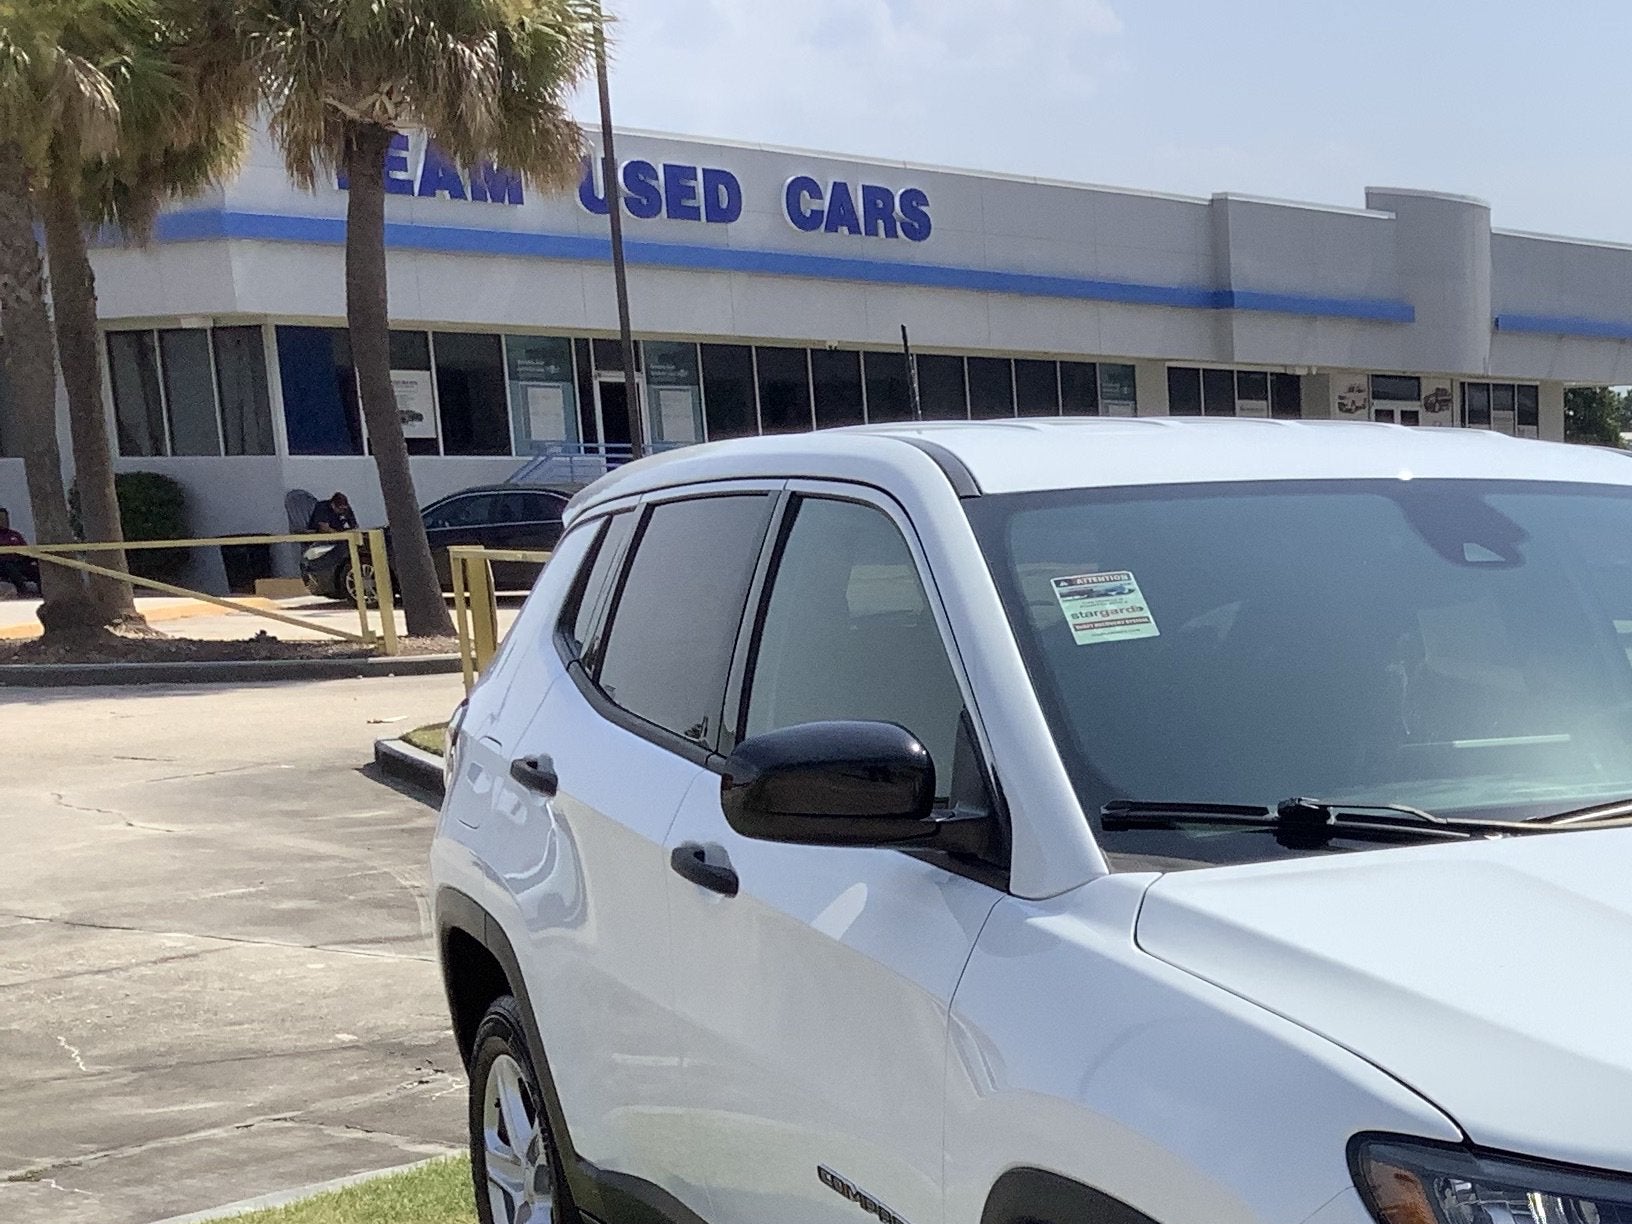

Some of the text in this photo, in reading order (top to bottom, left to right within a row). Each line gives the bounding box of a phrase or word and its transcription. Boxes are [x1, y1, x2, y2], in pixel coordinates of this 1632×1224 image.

[337, 133, 932, 242] EAM USED CARS
[1076, 573, 1129, 584] ATTENTION
